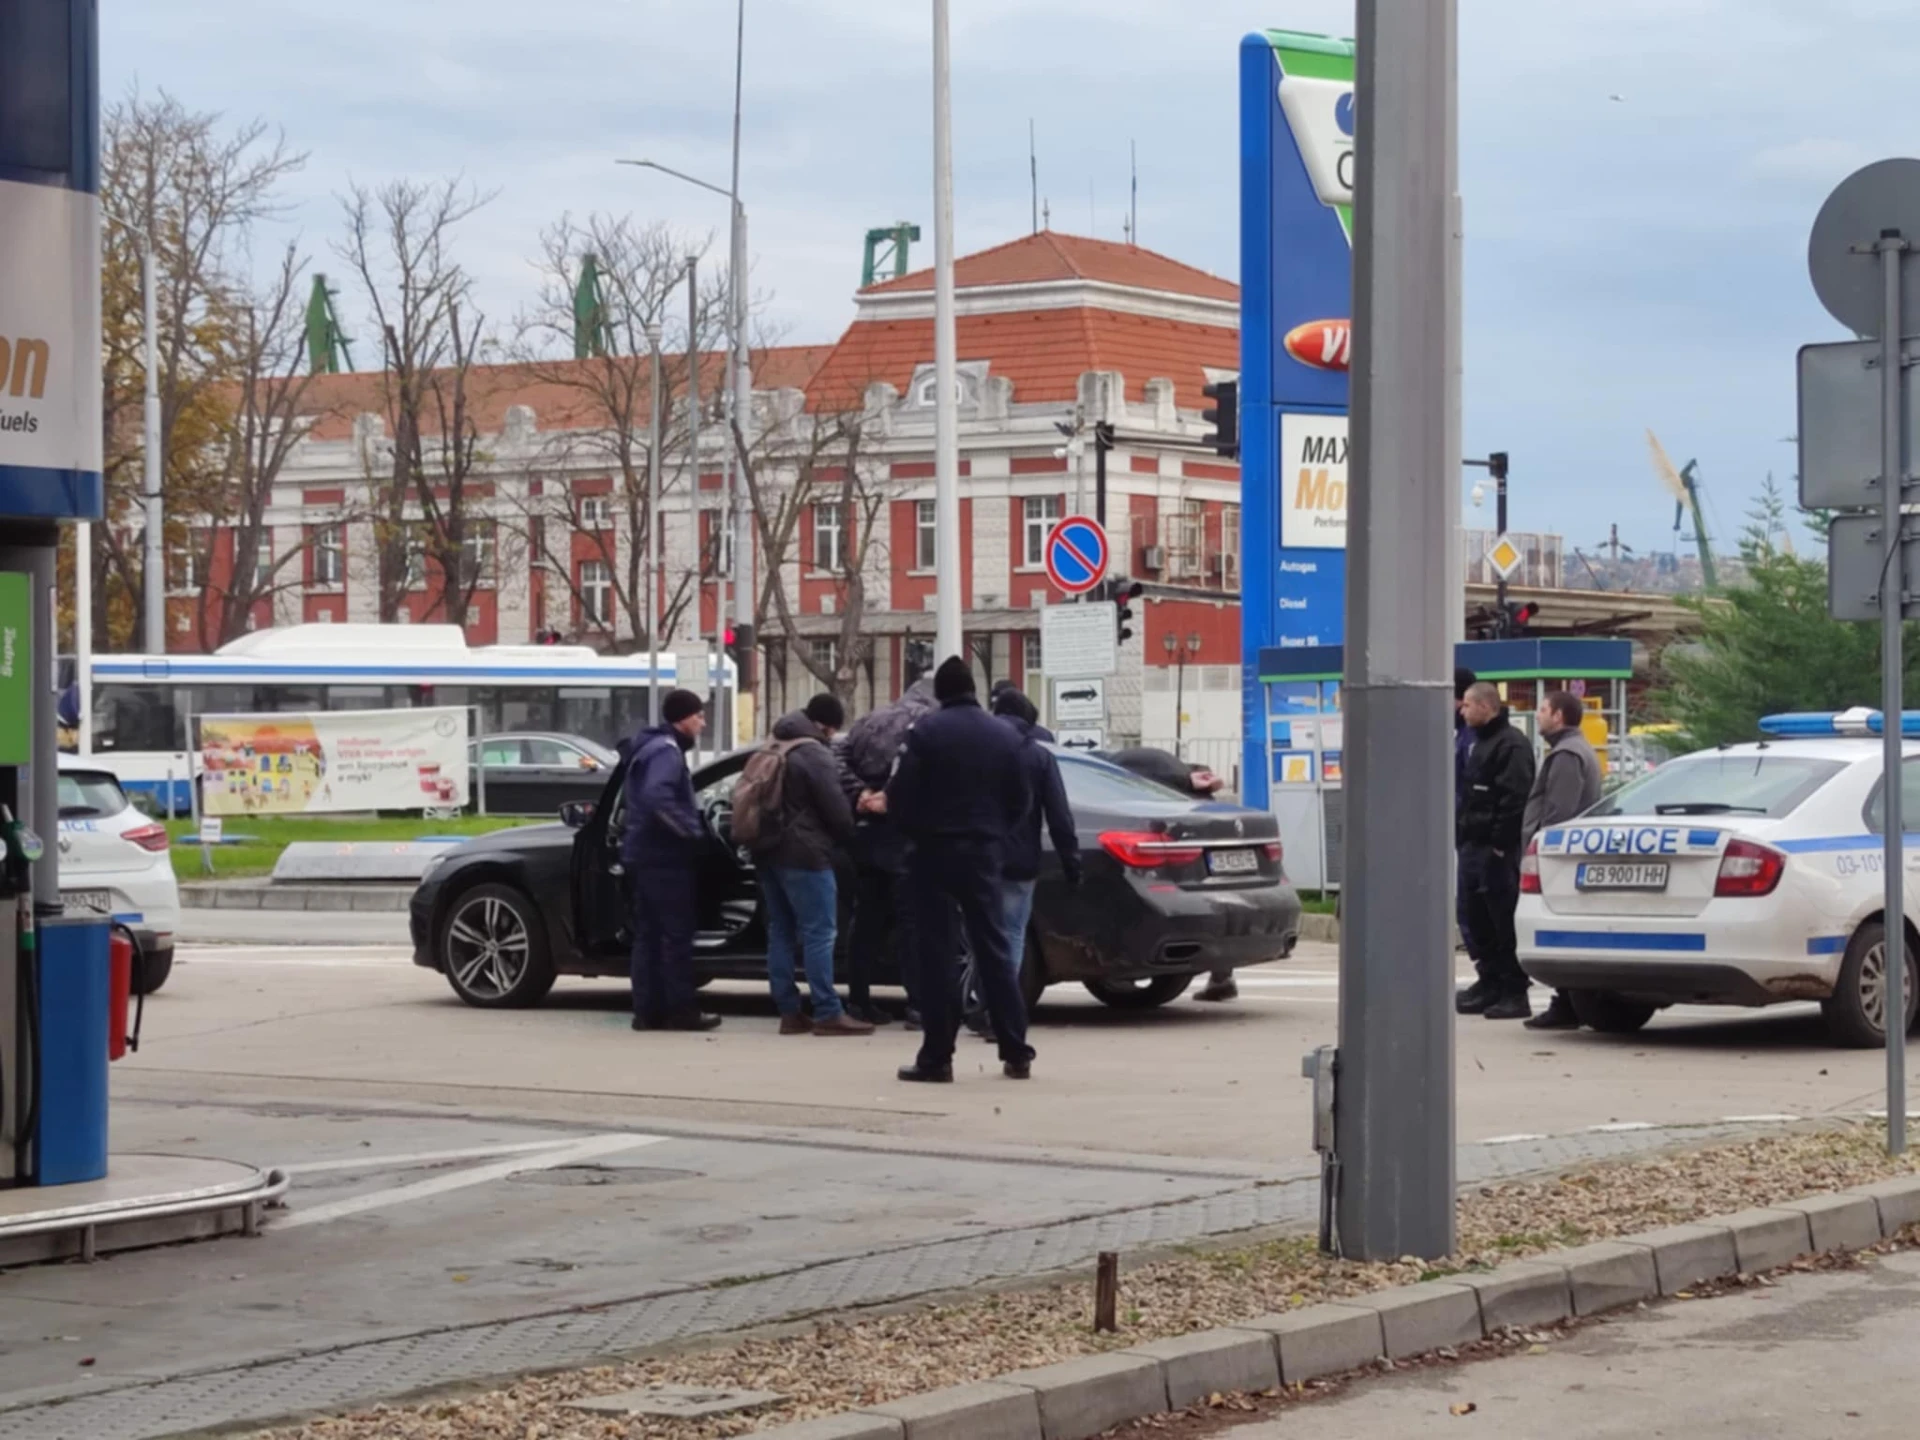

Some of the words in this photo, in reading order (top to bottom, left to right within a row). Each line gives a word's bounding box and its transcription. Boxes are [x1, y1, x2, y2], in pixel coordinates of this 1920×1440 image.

[0, 409, 39, 433] uels
[1301, 435, 1349, 464] MAX
[1566, 828, 1680, 854] POLICE
[1608, 864, 1641, 883] 9001
